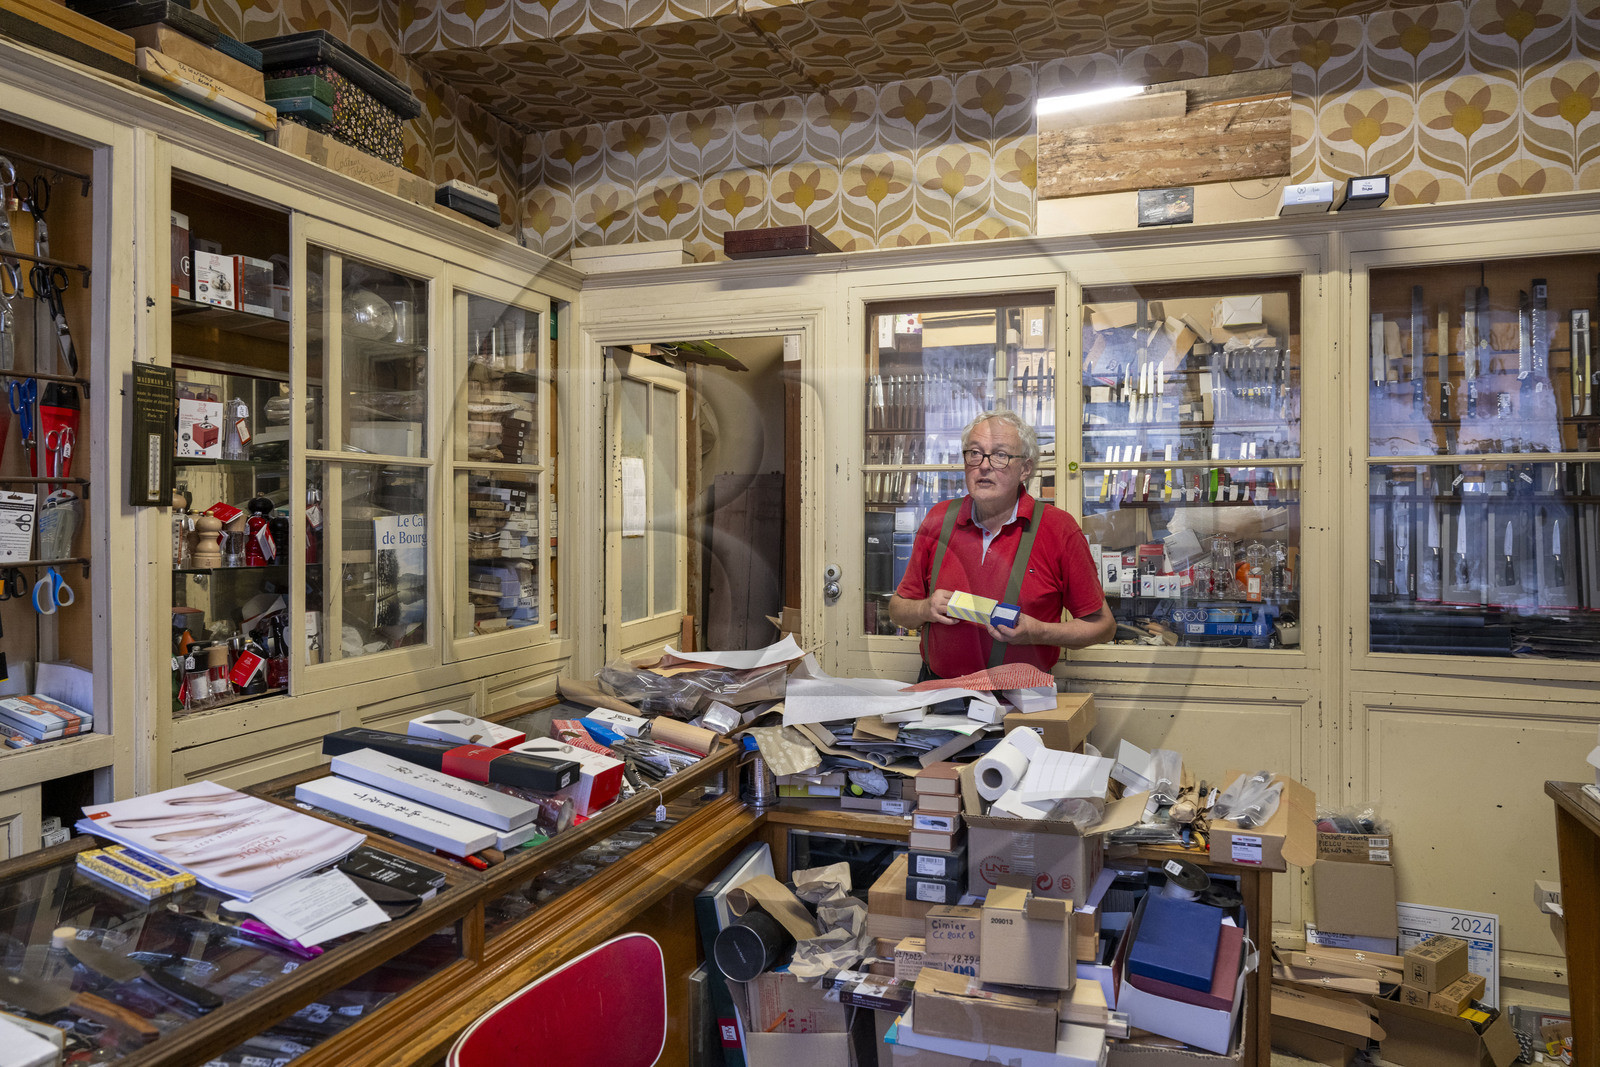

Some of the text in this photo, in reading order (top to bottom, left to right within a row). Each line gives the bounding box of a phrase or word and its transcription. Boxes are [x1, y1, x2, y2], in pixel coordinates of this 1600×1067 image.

[397, 514, 410, 528] Le
[382, 531, 396, 545] de
[239, 835, 287, 859] LAGUIOLE
[985, 863, 1010, 873] LNE
[931, 919, 966, 930] Cimier
[990, 917, 1014, 925] 209013
[1451, 916, 1492, 935] 2024
